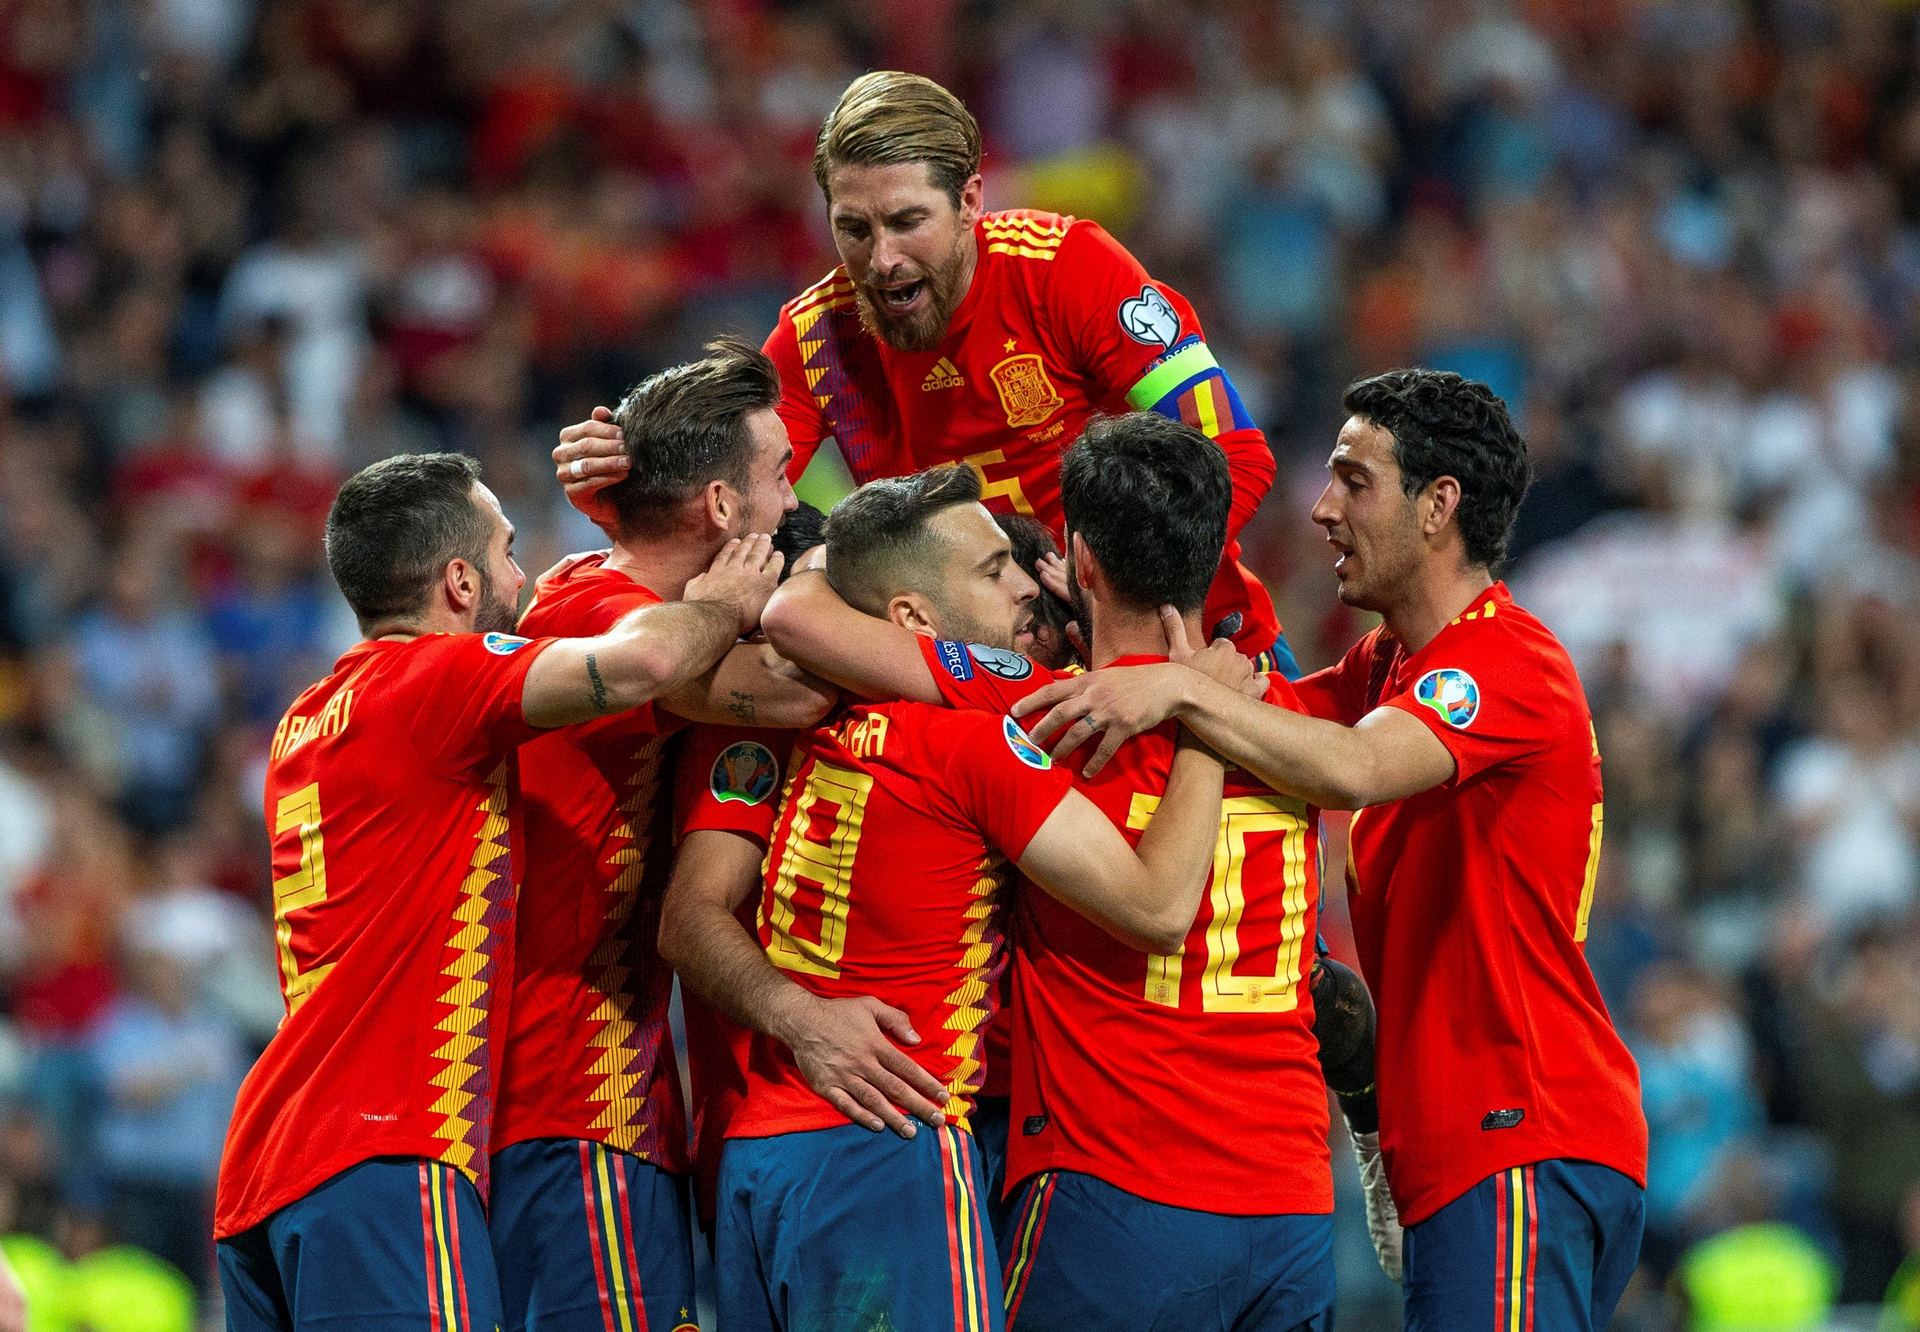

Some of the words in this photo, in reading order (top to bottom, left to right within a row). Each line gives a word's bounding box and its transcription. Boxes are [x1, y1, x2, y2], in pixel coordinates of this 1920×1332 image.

[921, 375, 965, 392] adidas
[931, 449, 1035, 514] 5
[273, 781, 337, 1017] 2
